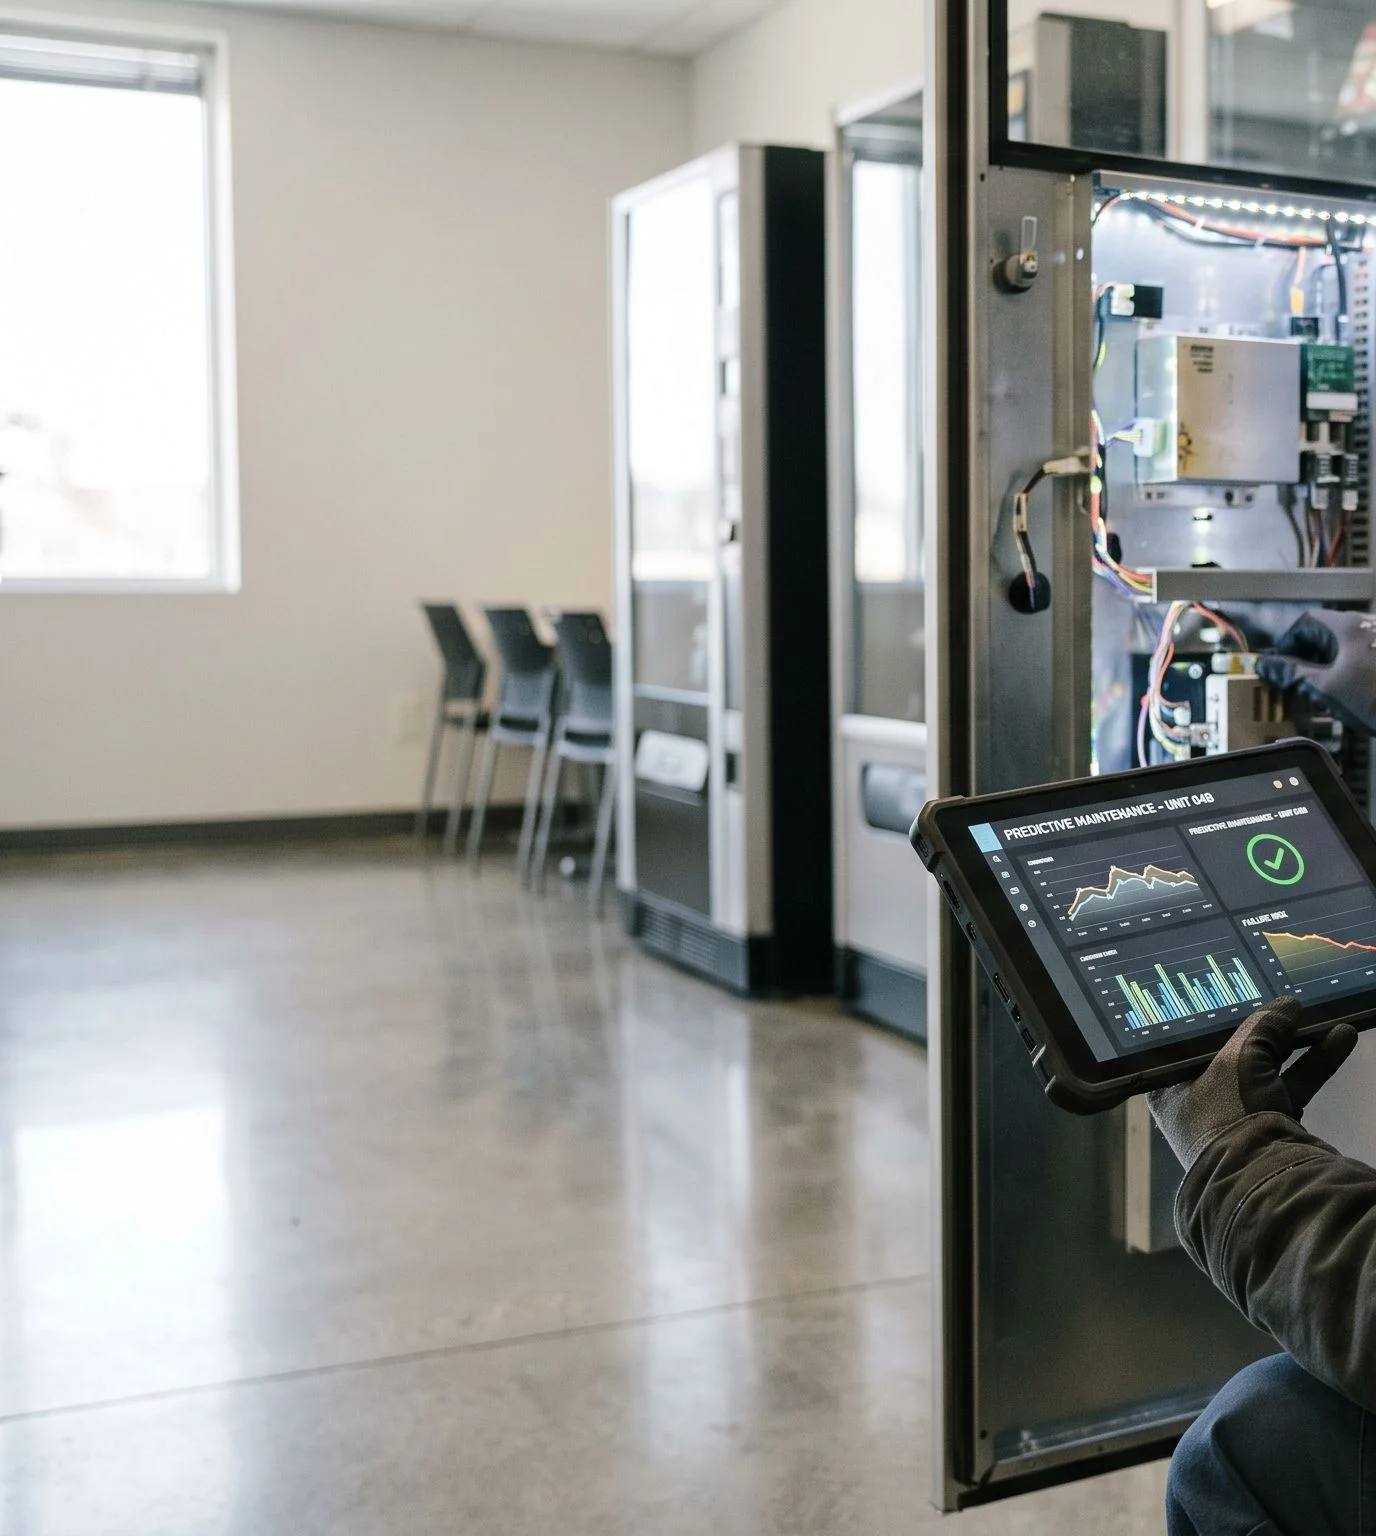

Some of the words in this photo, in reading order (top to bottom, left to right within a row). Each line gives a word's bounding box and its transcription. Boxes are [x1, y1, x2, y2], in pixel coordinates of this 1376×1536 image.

[1003, 817, 1076, 841] PREDICTIVE
[1073, 802, 1157, 827] MAINTENANCE
[1163, 796, 1191, 812] UNIT
